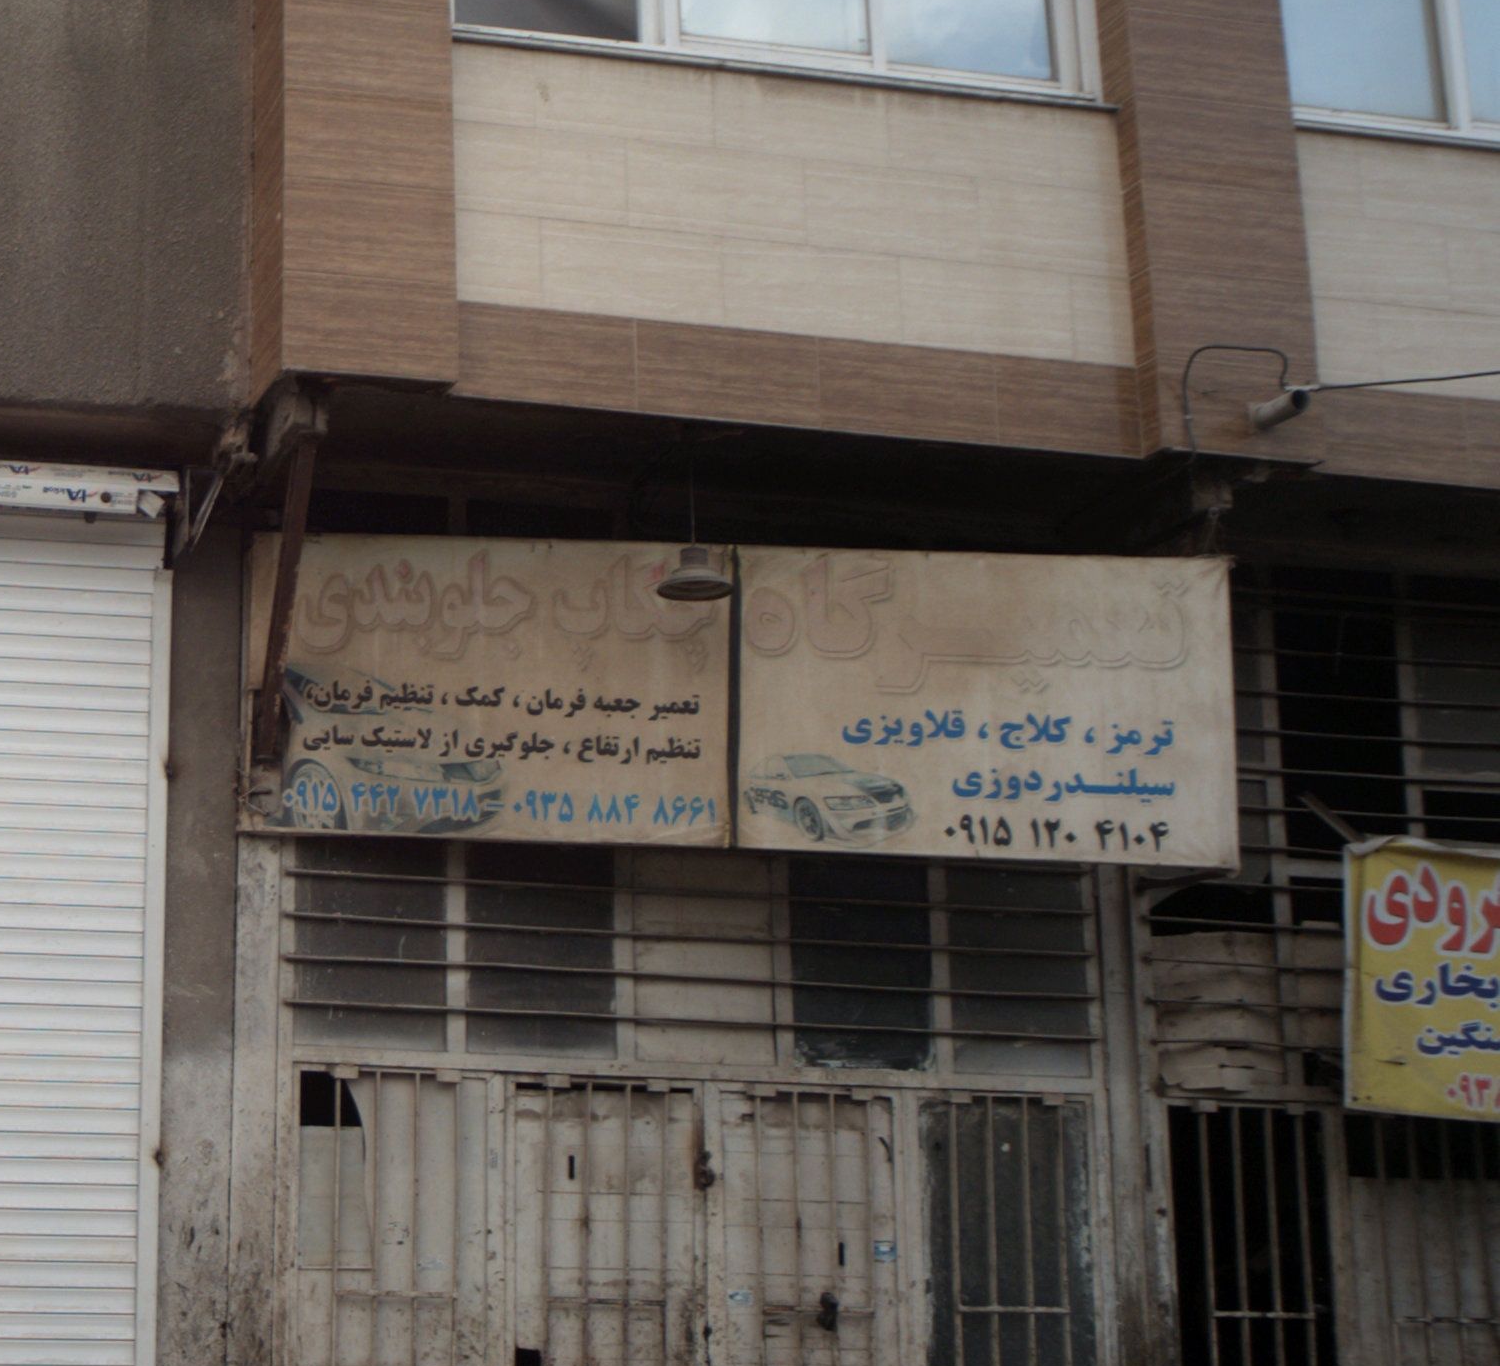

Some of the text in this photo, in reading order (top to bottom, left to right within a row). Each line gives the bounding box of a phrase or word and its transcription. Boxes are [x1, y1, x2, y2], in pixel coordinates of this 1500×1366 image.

[379, 683, 434, 710] تنظیم
[456, 686, 505, 708] کمک
[526, 687, 587, 718] فرمان
[593, 696, 641, 719] جعبه
[647, 693, 700, 721] تعمیر
[361, 726, 433, 753] لاستیک
[842, 709, 966, 747] قلاویزی
[999, 713, 1072, 750] کلاج
[1106, 720, 1175, 756] ترمز
[439, 729, 459, 758] از
[464, 731, 555, 760] جلوگیری
[577, 736, 640, 765] ارتفاع
[646, 737, 701, 765] تنظیم
[284, 780, 338, 813] ۰۹۱۵
[413, 785, 480, 820] ۷۳۱۸
[513, 789, 574, 823] ۰۹۳۵
[587, 794, 641, 824] ۸۸۴
[653, 795, 716, 826] ۸۶۶۱
[944, 814, 1169, 852] ۰۹۱۵ ۱۲۰ ۴۱۰۴
[1367, 866, 1500, 954] رودی
[1417, 1022, 1500, 1055] نگین
